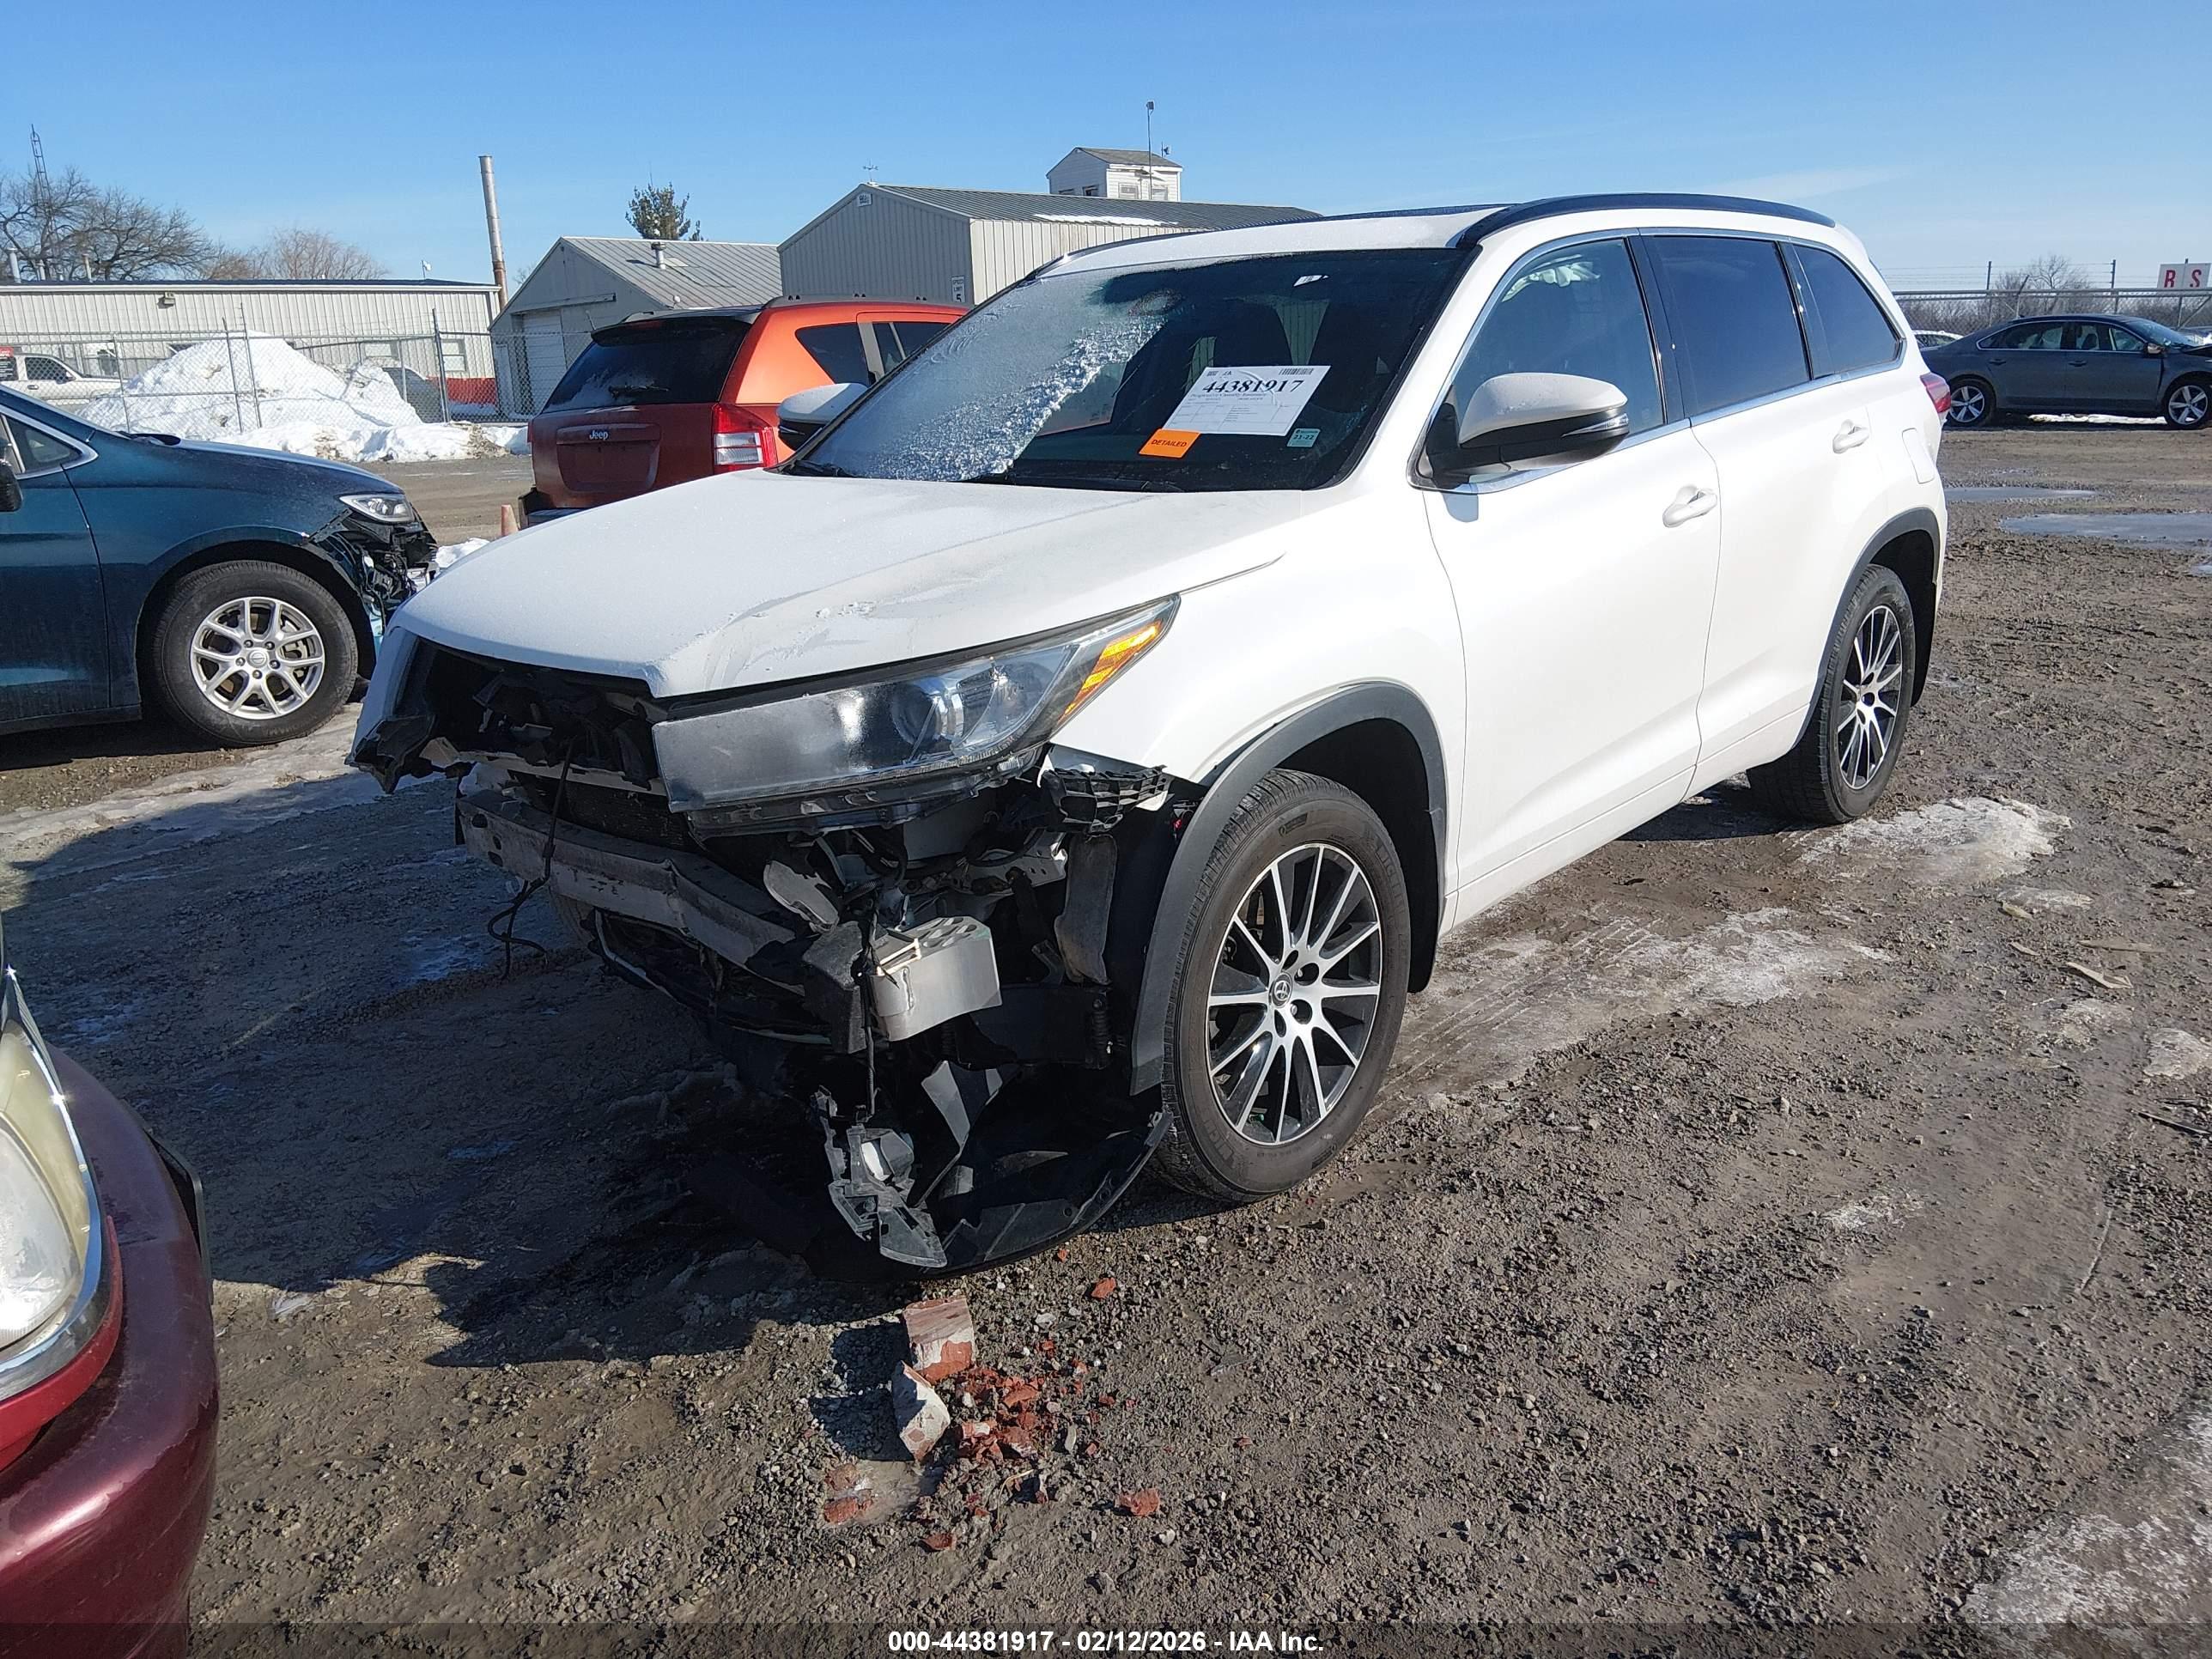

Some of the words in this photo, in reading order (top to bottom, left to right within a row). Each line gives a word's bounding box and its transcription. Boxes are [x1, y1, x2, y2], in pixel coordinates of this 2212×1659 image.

[2164, 269, 2176, 288] R
[2190, 269, 2202, 288] S
[1202, 380, 1304, 393] 44381917
[589, 429, 609, 441] Jeep
[1151, 438, 1187, 447] DETAILED
